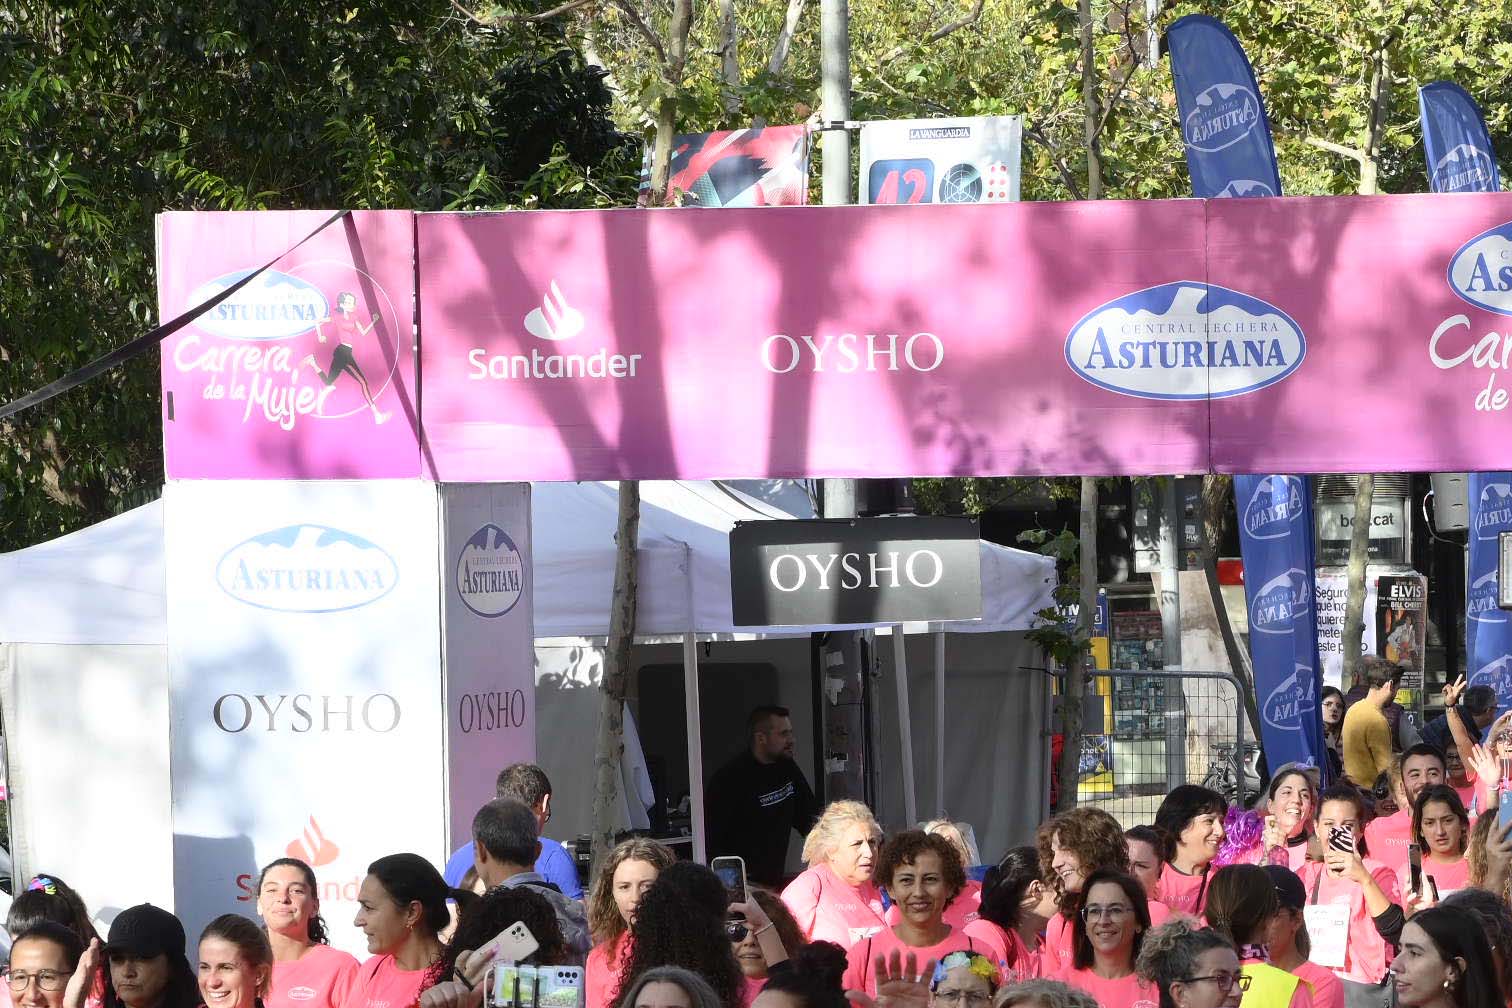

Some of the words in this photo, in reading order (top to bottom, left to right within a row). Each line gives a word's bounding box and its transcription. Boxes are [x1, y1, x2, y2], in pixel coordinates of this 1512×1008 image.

[919, 127, 970, 138] VANGUARDIA
[208, 303, 318, 320] STURIANA
[1120, 323, 1196, 335] CENTRAL
[1202, 322, 1280, 333] LECHERA
[173, 335, 291, 372] Carrera
[468, 347, 641, 379] Santander
[761, 332, 944, 373] OYSHO
[1084, 327, 1288, 369] ASTURIANA
[203, 375, 223, 400] de
[230, 371, 248, 400] la
[243, 370, 336, 431] Mujer
[1475, 372, 1509, 411] de
[1340, 513, 1394, 527] b.cat
[462, 559, 520, 595] ASTURIANA
[769, 548, 943, 592] OYSHO
[1391, 584, 1422, 598] ELVIS
[213, 693, 402, 733] OYSHO
[459, 688, 526, 734] OYSHO
